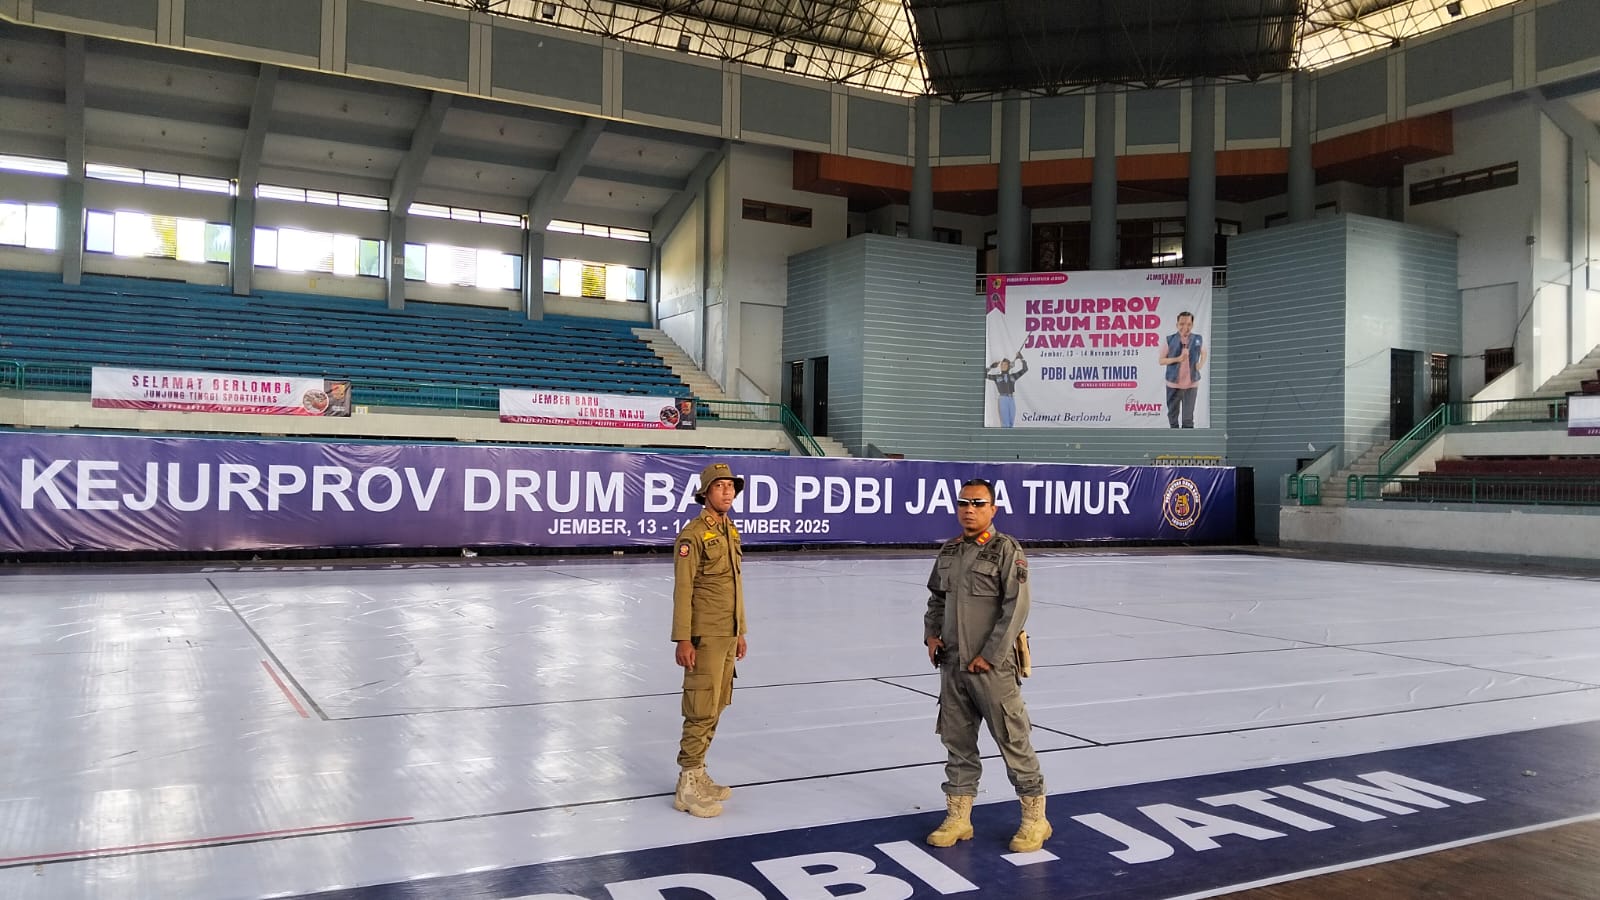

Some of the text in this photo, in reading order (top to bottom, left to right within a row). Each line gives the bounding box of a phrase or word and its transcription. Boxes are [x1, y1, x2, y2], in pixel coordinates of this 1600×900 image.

[1025, 296, 1161, 315] KEJURPROV
[1025, 314, 1161, 332] DRUM BAND
[1025, 332, 1159, 349] JAWA TIMUR
[1041, 365, 1138, 381] PDBI JAWA TIMUR
[132, 375, 292, 394] SELAMAT BERLOMBA
[143, 389, 185, 401] JUNJUNG
[532, 393, 599, 407] JEMBER BARU
[578, 407, 645, 419] JEMBER MAJU
[1125, 403, 1162, 412] FAWAIT
[1022, 411, 1112, 422] Selamat Berlomba
[20, 457, 445, 513] KEJURPROV
[463, 468, 625, 513] DRUM
[794, 475, 893, 515] PDBI
[905, 478, 1013, 515] JAA
[1022, 480, 1130, 515] TIMUR
[548, 518, 631, 537] JEMBER,
[637, 519, 657, 534] 13
[737, 519, 791, 534] EMBER
[795, 519, 830, 534] 2025
[1071, 770, 1487, 864] JATIM
